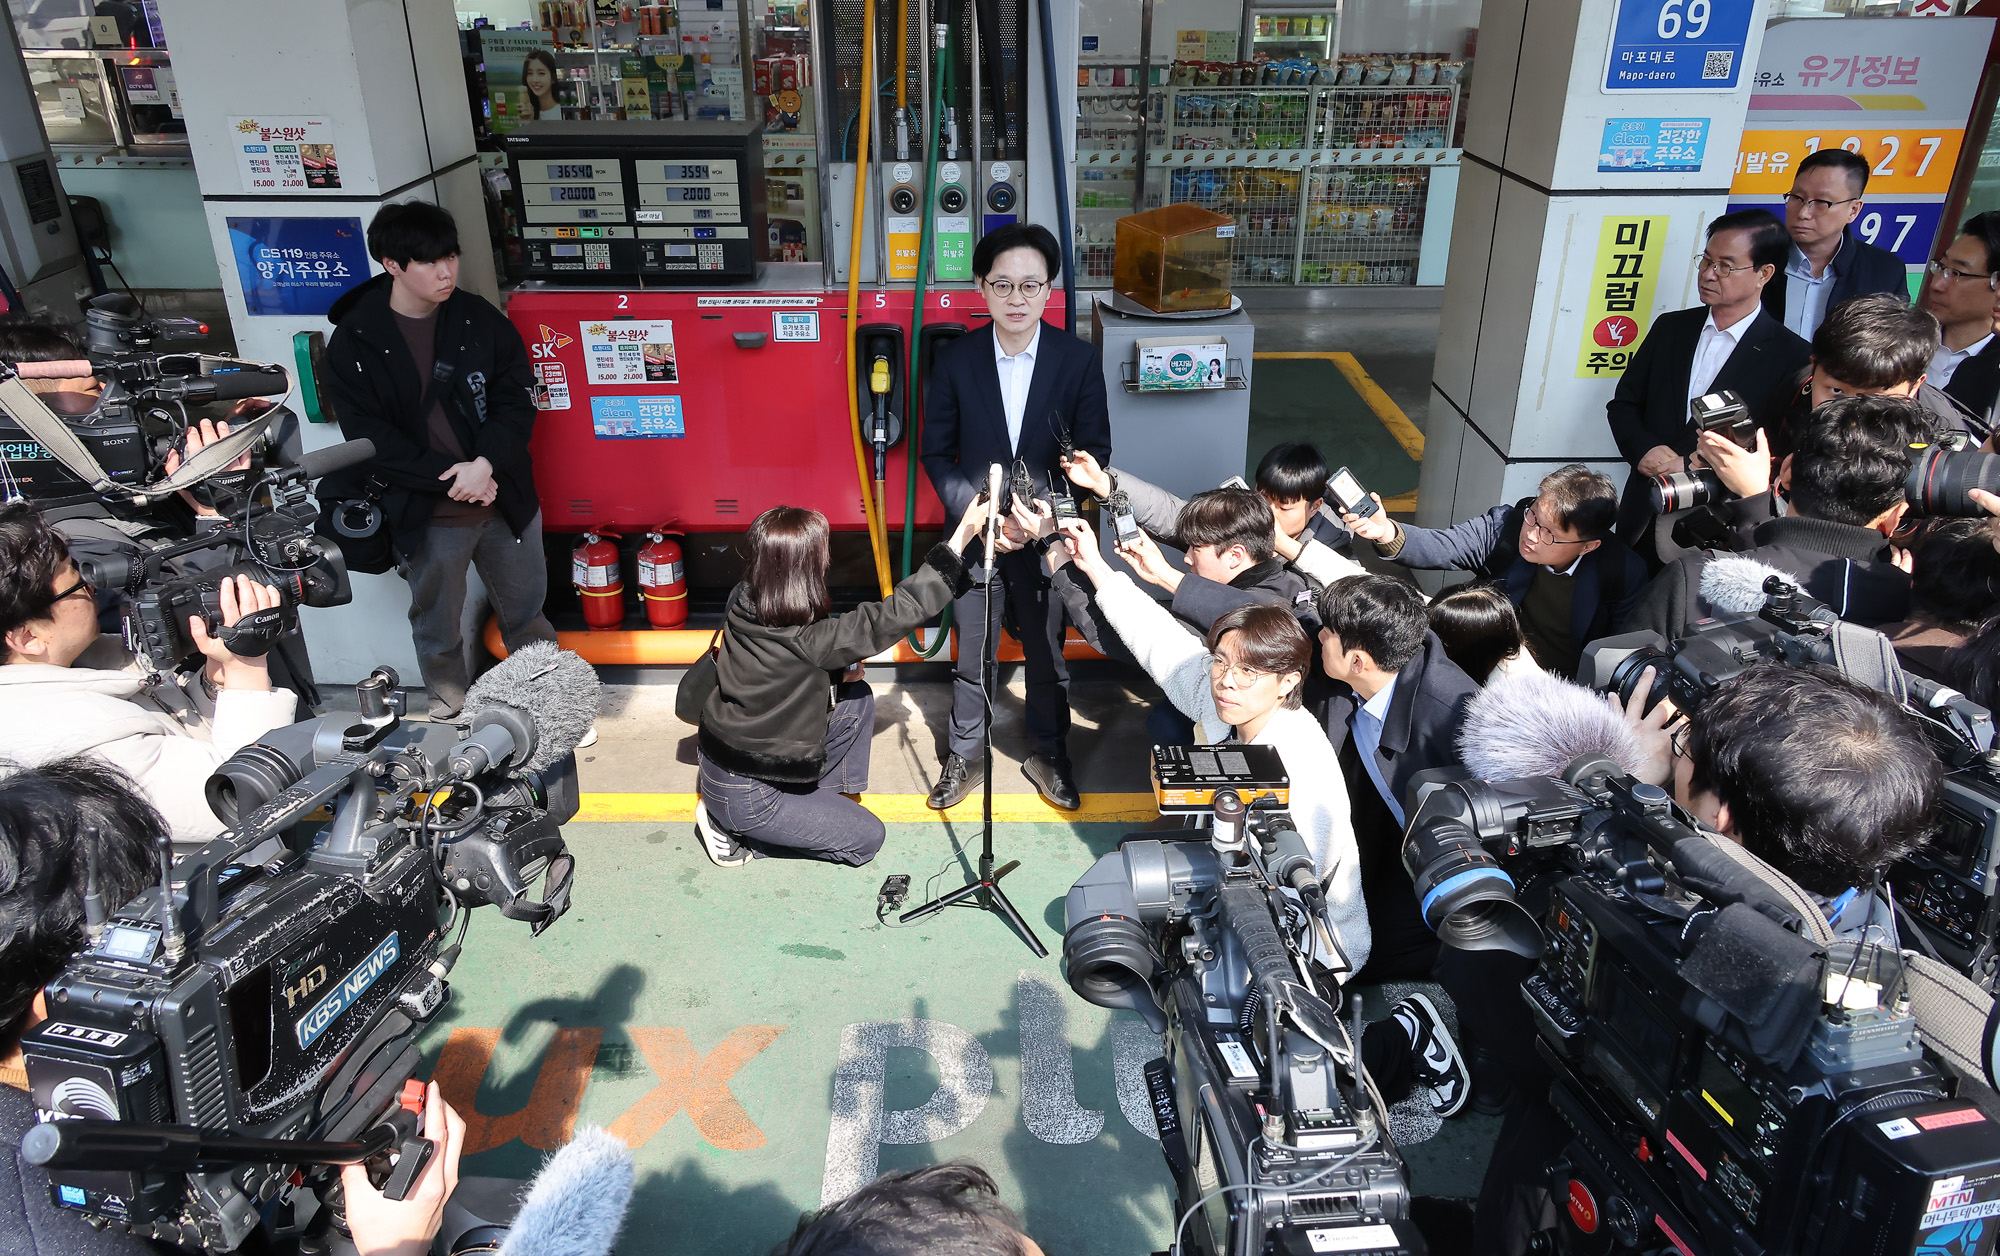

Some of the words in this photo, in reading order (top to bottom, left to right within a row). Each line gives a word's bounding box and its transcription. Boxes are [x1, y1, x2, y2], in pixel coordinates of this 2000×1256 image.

[1657, 0, 1711, 39] 69
[1621, 51, 1675, 64] 마포대로
[1619, 70, 1676, 81] Mapo-daero
[1798, 55, 1920, 88] 유가정보
[259, 127, 306, 141] 불스원샷
[1612, 132, 1650, 145] Clean
[1658, 130, 1701, 144] 건강한
[1654, 146, 1696, 160] 주유소
[558, 165, 592, 178] 36540
[681, 166, 709, 178] 3594
[541, 228, 548, 236] 5
[608, 227, 614, 236] 6
[683, 229, 689, 237] 7
[896, 249, 917, 257] 휘발유
[257, 261, 351, 279] 양지주유소
[1605, 220, 1650, 312] 미끄럼
[618, 296, 628, 309] 2
[875, 294, 886, 308] 5
[940, 294, 951, 308] 6
[607, 330, 648, 342] 불스원샷
[531, 343, 556, 358] SK
[1586, 351, 1633, 374] 주의
[600, 407, 633, 417] Clean
[639, 405, 676, 416] 건강한
[641, 418, 677, 429] 주유소
[103, 438, 131, 446] SONY
[255, 612, 280, 624] Canon
[286, 964, 327, 1009] HD
[303, 992, 342, 1041] KBS
[344, 939, 397, 1002] NEWS
[1859, 1024, 1900, 1035] SENNHEISER
[1569, 1192, 1584, 1212] MTN
[1929, 1191, 1972, 1210] MTN
